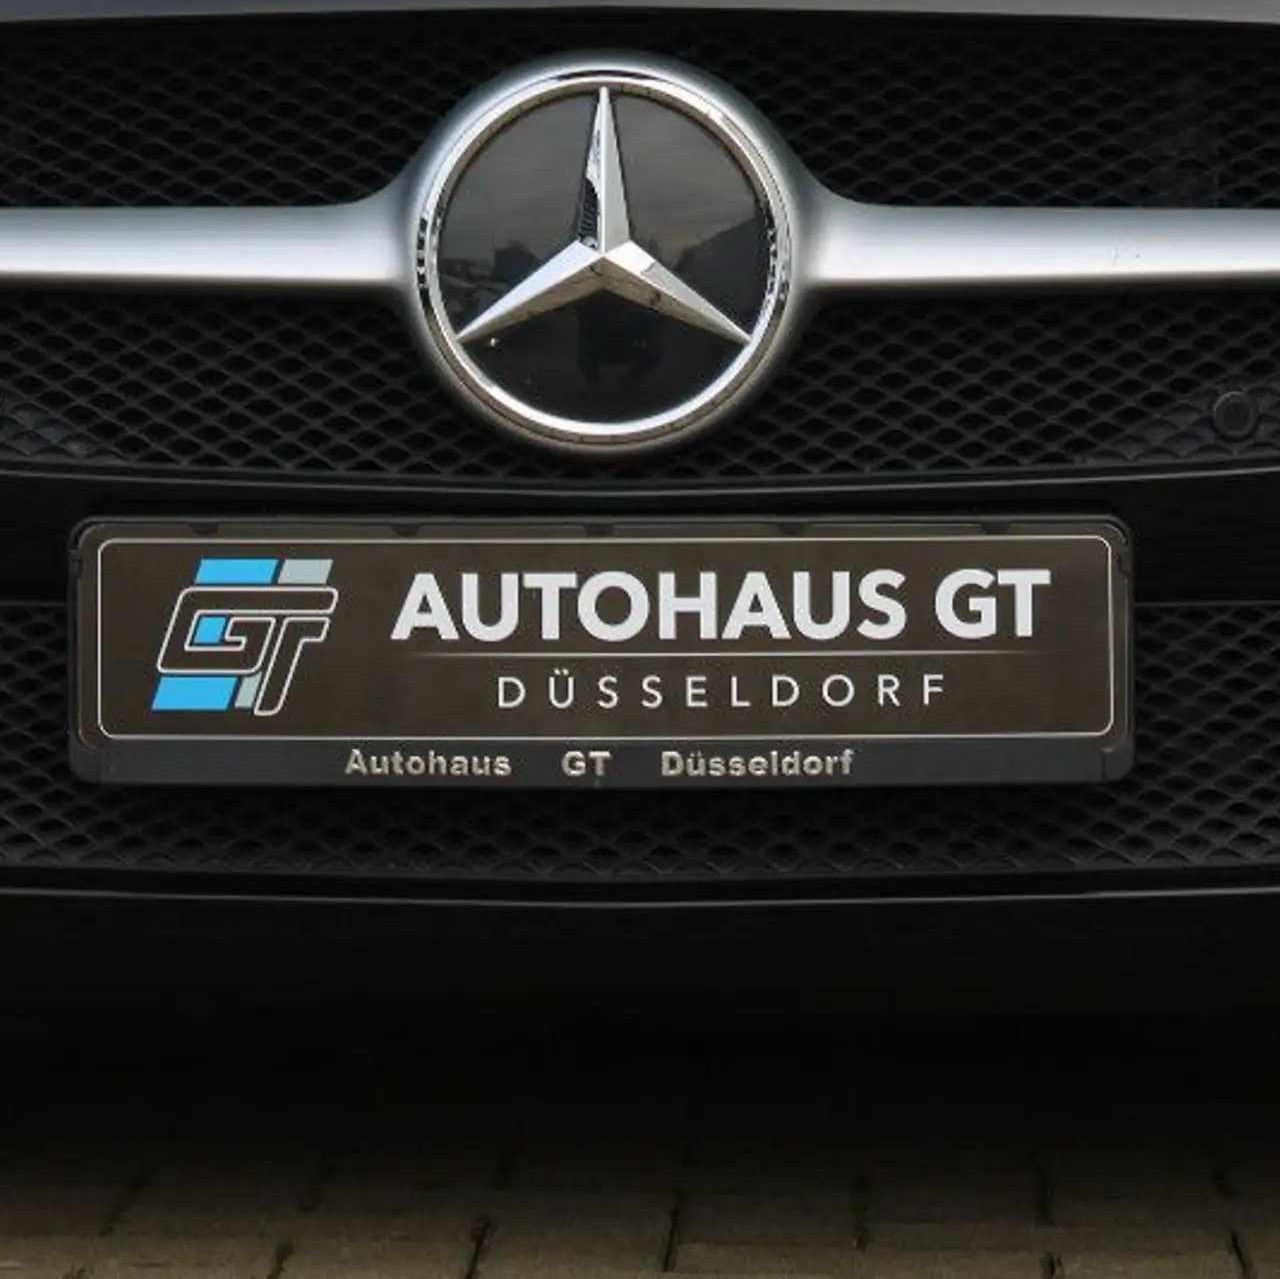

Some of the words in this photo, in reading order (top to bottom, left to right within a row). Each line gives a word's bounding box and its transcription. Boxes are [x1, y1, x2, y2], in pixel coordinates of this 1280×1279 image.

[389, 568, 907, 642] AUTOHAUS
[934, 568, 1053, 640] GT
[156, 585, 339, 716] GT
[496, 666, 946, 710] DÜSSELDORF
[345, 748, 513, 777] Autohaus
[560, 750, 612, 777] GT
[660, 748, 856, 777] Düsseldorf
